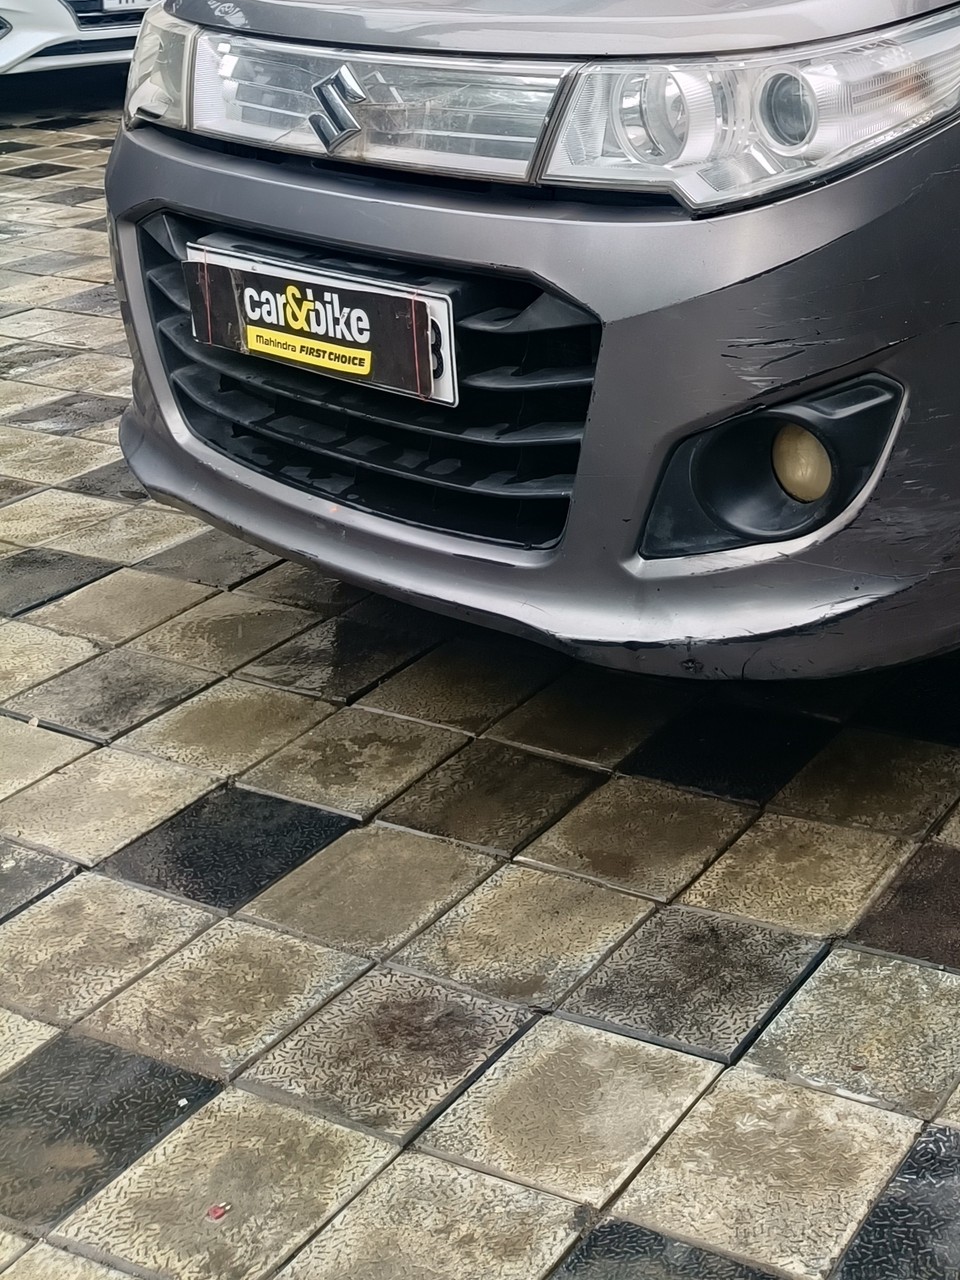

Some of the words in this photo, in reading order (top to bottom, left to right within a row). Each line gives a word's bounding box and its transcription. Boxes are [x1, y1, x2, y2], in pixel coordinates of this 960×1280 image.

[244, 285, 370, 344] car&bike
[255, 335, 297, 353] Mahindra
[299, 345, 328, 360] FIRST
[328, 349, 366, 367] CHOICE
